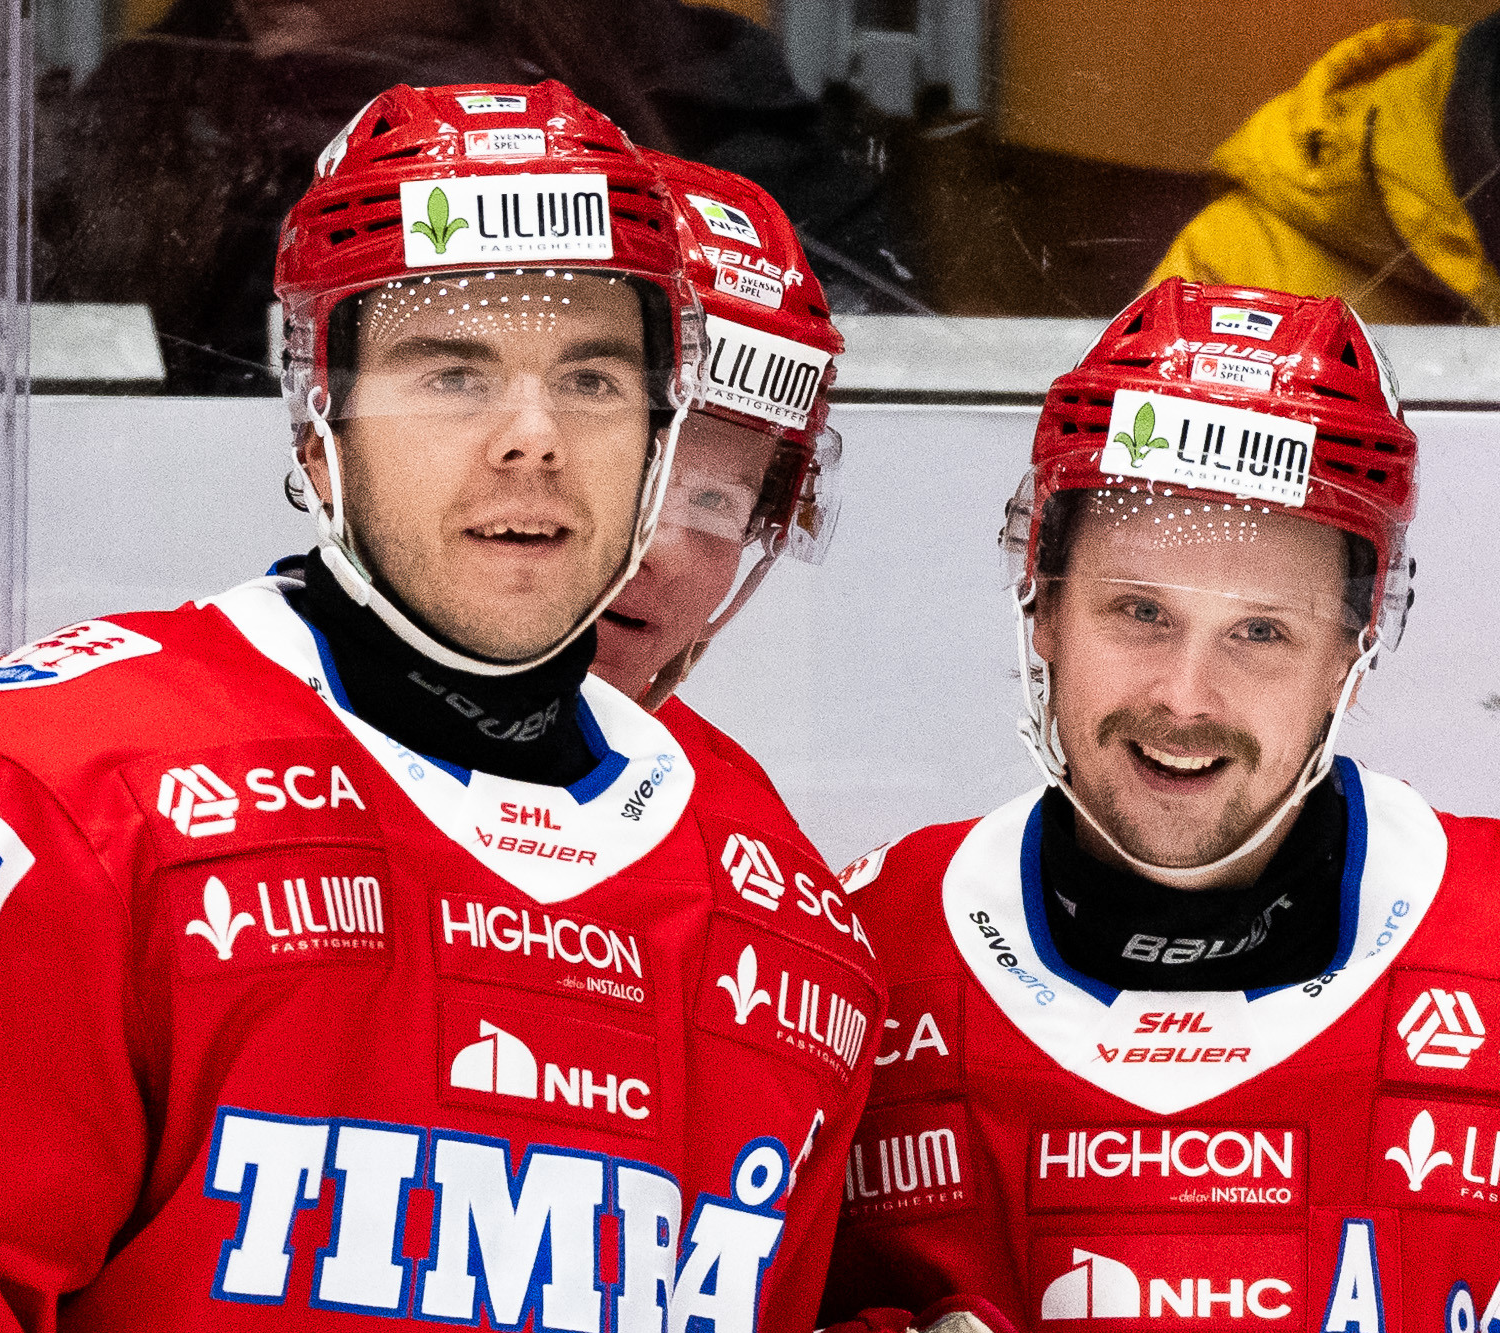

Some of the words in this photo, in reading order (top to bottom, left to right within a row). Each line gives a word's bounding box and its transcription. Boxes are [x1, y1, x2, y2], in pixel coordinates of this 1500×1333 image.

[494, 141, 520, 150] SPEL
[476, 192, 605, 239] LILIUM
[708, 218, 758, 240] NHC
[739, 285, 761, 299] SPEL
[741, 275, 782, 295] SVENSKA
[709, 337, 820, 411] LILIUM
[1219, 371, 1246, 383] SPEL
[1221, 361, 1271, 377] SVENSKA
[706, 387, 806, 424] ASTIGHETER
[1176, 418, 1308, 485] LILIUM
[247, 765, 367, 813] SCA
[500, 801, 562, 831] SHL
[257, 875, 385, 938] LILIUM
[795, 879, 876, 959] SCA
[270, 936, 386, 955] FASTIGHETER
[440, 898, 643, 979] HIGHCON
[585, 978, 645, 1003] INSTALCO
[776, 970, 868, 1071] LILIUM
[880, 1012, 949, 1067] CA
[1134, 1009, 1213, 1034] SHL
[544, 1068, 651, 1121] NHC
[845, 1127, 962, 1199] ILIUM
[1039, 1129, 1293, 1181] HIGHCON
[1210, 1187, 1292, 1205] INSTALCO
[1148, 1278, 1293, 1320] NHC
